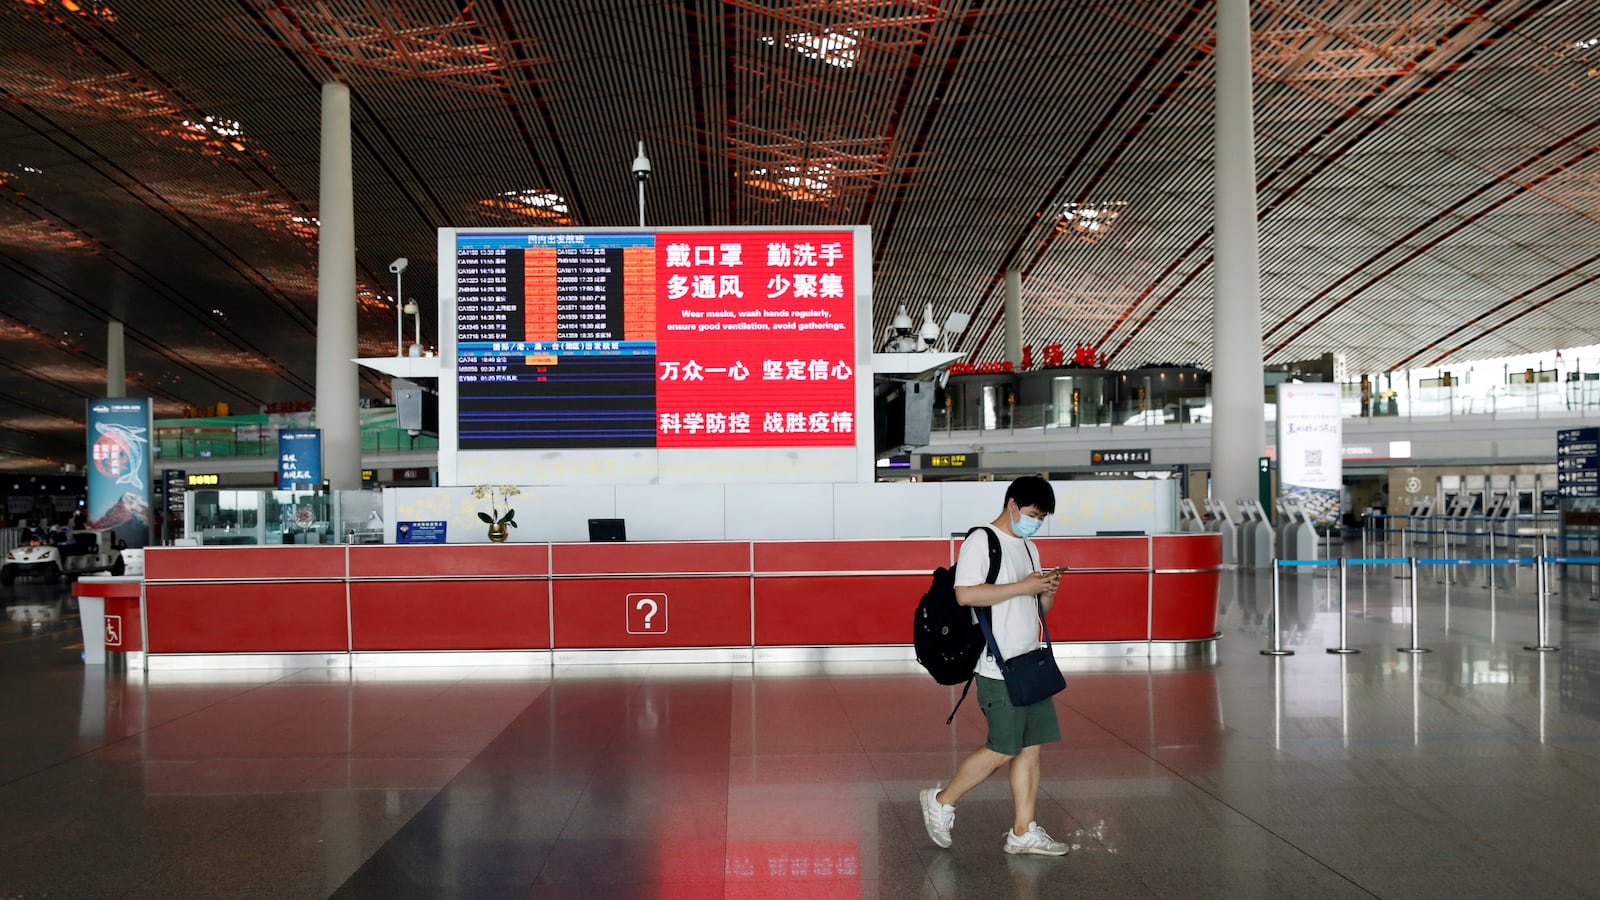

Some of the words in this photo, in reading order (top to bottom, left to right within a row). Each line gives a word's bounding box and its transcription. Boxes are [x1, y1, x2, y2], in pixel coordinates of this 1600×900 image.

[666, 243, 743, 267] 戴口罩
[767, 242, 844, 267] 勤洗手
[666, 274, 744, 299] 多通风
[766, 273, 845, 298] 少聚集
[681, 310, 704, 318] Wear
[706, 310, 736, 319] masks,
[738, 309, 761, 318] wash
[763, 309, 789, 318] hands
[791, 309, 831, 319] regularly,
[667, 323, 696, 331] ensure
[698, 322, 720, 332] good
[722, 322, 770, 331] ventilation,
[772, 322, 796, 330] avoid
[798, 321, 846, 332] gatherings.
[659, 360, 750, 381] 万众一心
[762, 359, 853, 381] 坚定信心
[660, 412, 751, 434] 科学防控
[763, 411, 853, 433] 战胜疫情
